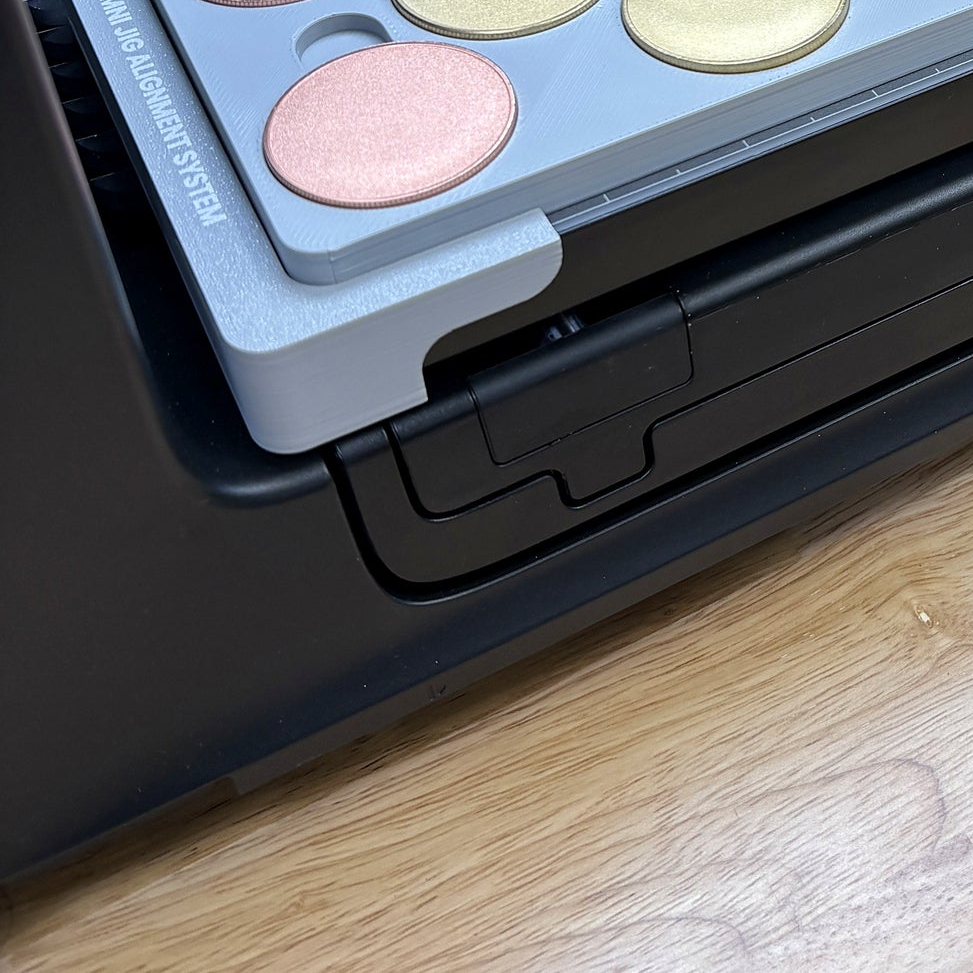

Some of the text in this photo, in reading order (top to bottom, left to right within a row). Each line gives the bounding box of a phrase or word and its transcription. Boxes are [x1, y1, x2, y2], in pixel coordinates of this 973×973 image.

[114, 26, 144, 52] JIG
[127, 54, 192, 151] ALIGNMENT
[173, 149, 227, 226] SYSTEM
